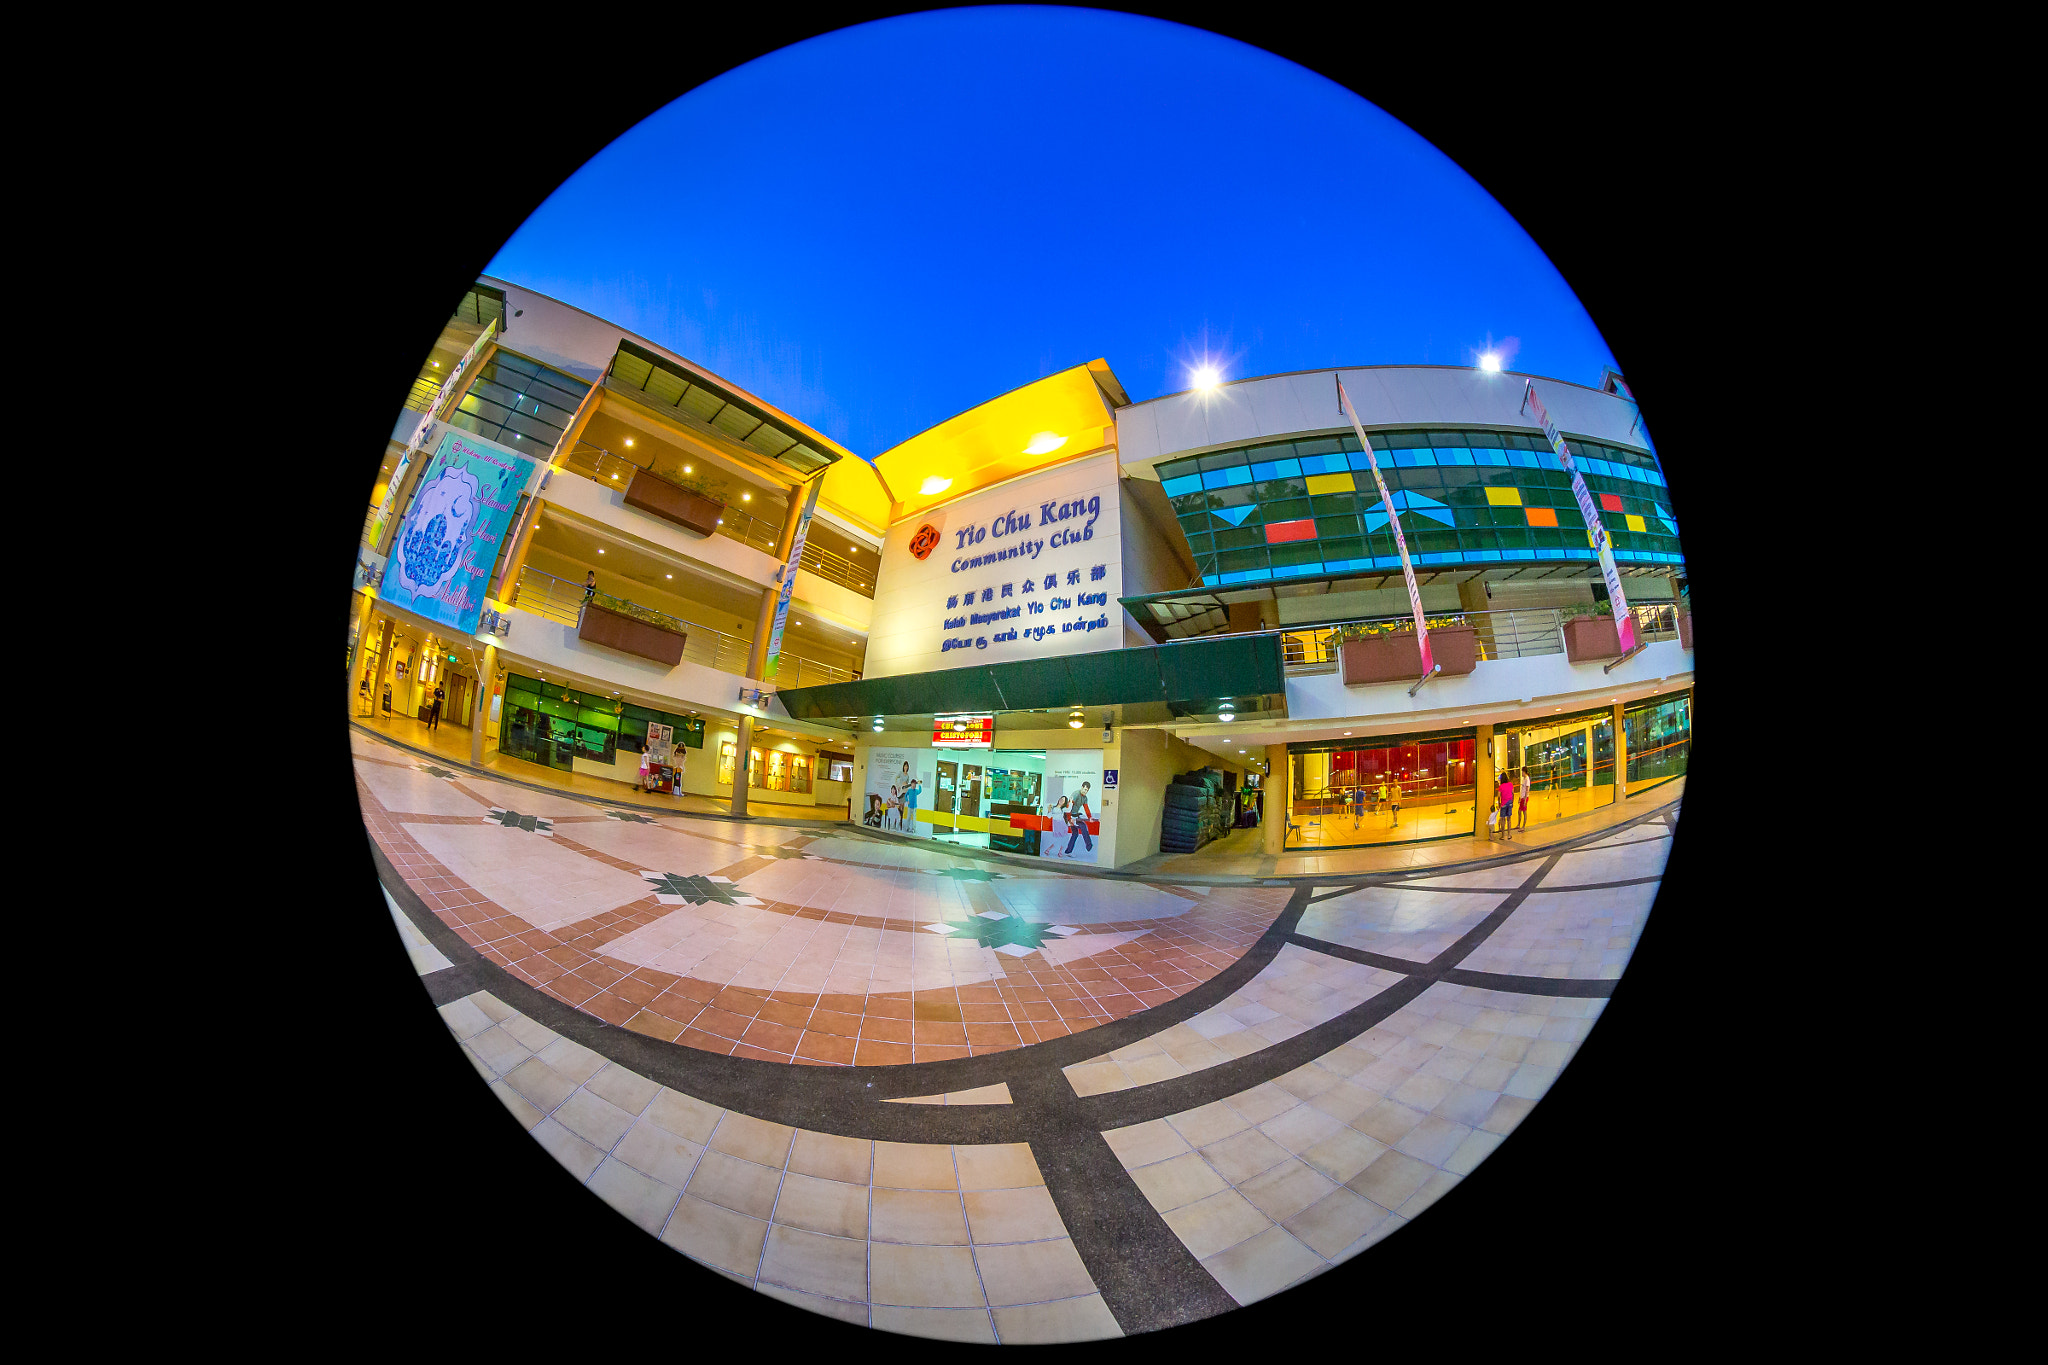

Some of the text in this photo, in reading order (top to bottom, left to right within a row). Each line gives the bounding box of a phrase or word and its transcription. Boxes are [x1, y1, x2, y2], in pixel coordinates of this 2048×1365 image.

[472, 483, 512, 512] Selamat
[469, 519, 498, 544] Hari
[955, 495, 1101, 550] Yio Chu Kang
[459, 550, 486, 580] Raya
[950, 525, 1094, 574] Community Club
[943, 592, 1107, 631] Kelab Masyarakat Yio Chu Kang
